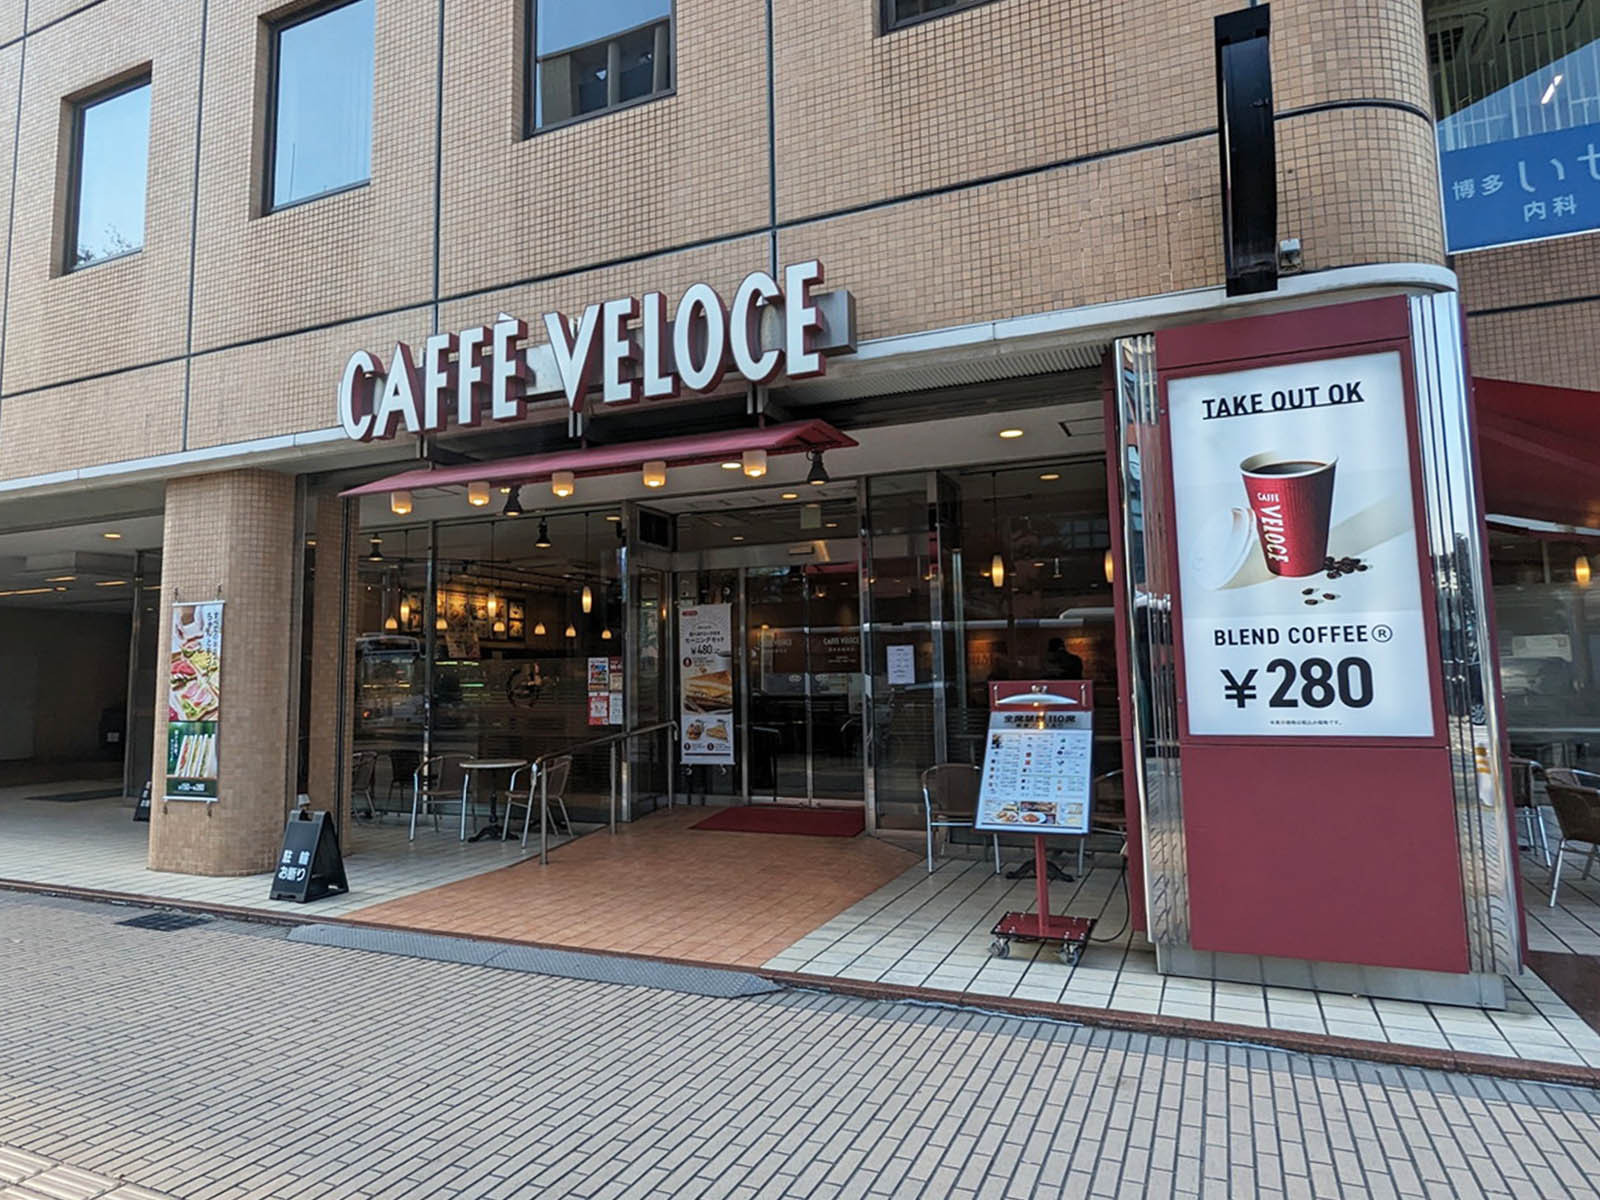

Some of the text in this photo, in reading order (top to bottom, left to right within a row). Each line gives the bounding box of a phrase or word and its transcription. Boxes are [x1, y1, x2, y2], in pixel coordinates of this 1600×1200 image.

[1452, 174, 1503, 200] 博多
[1523, 194, 1577, 222] 内科
[543, 260, 826, 413] VELOCE
[1202, 381, 1365, 420] TAKE OUT OK
[1258, 505, 1289, 563] VELOCE
[1214, 628, 1280, 646] BLEND
[1220, 657, 1374, 709] ¥280
